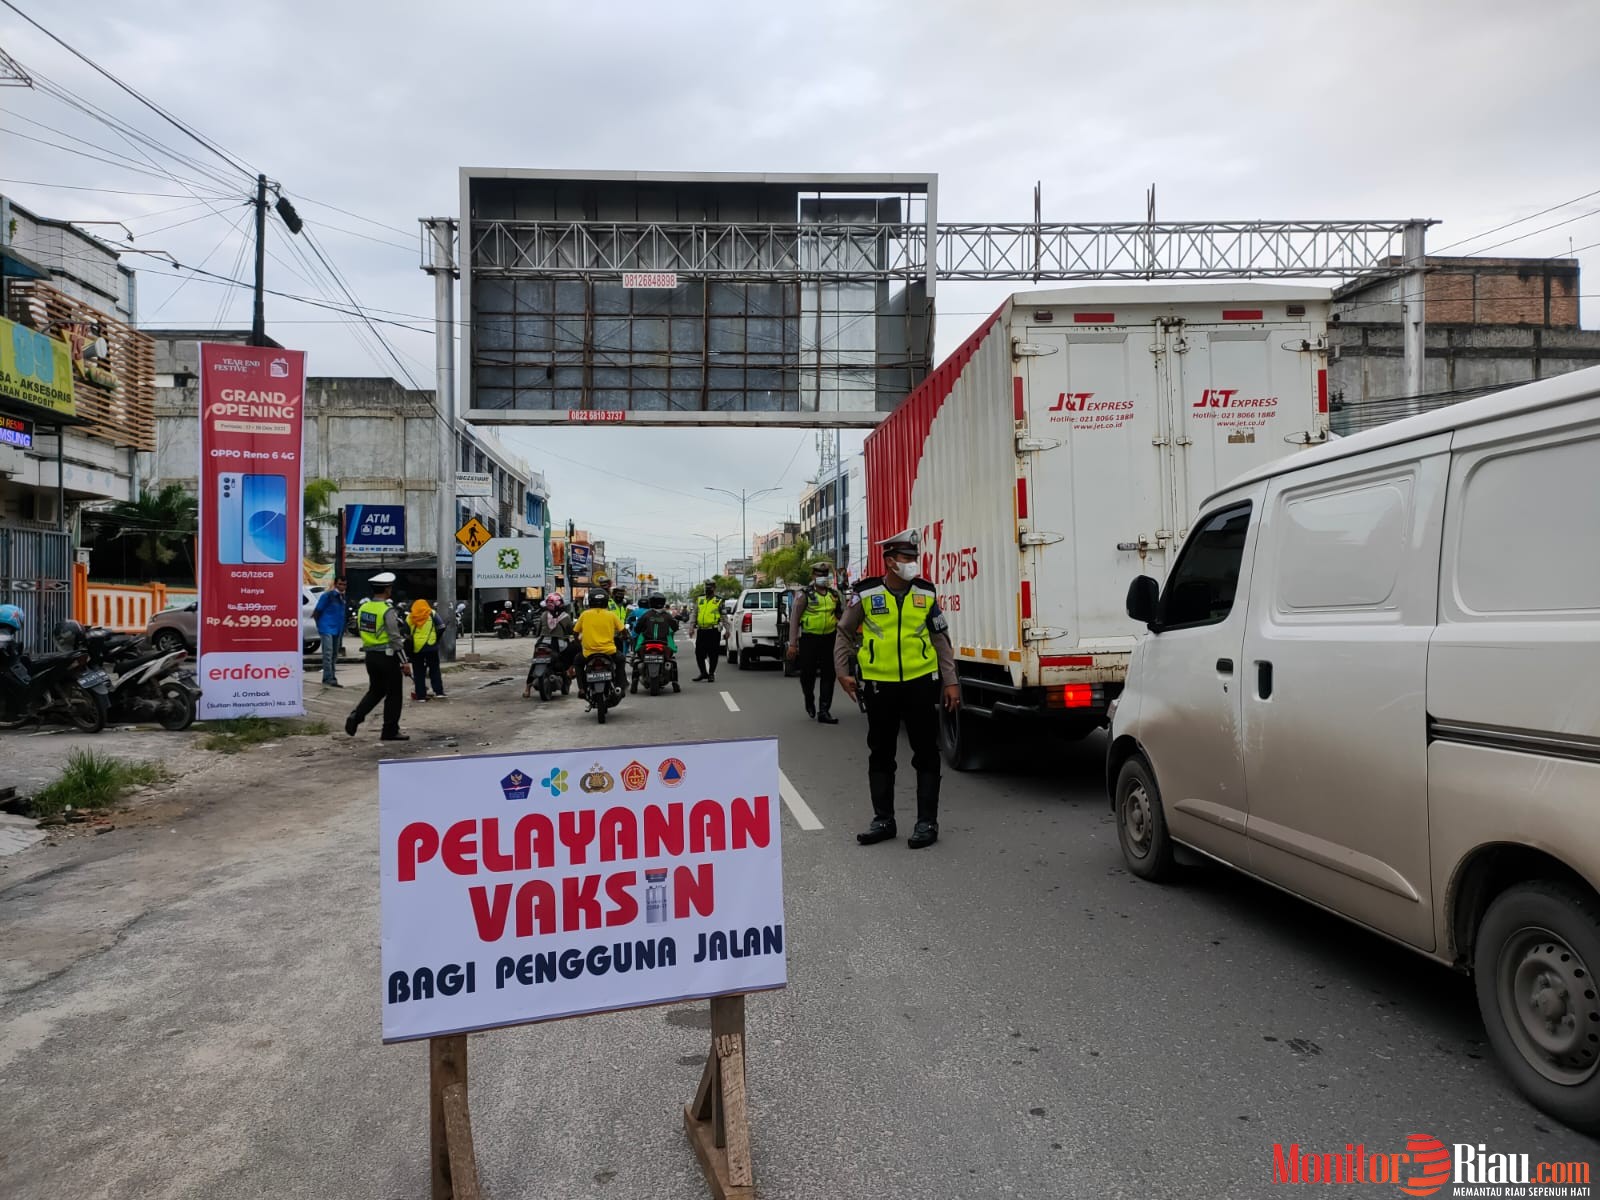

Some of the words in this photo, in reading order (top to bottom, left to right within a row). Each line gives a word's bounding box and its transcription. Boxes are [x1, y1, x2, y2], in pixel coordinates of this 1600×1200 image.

[214, 364, 247, 373] FESTIVE
[20, 378, 72, 403] AKSESORIS
[221, 388, 286, 405] GRAND
[23, 391, 54, 408] DEPOSIT
[1049, 392, 1095, 412] J&T
[1087, 400, 1134, 411] EXPRESS
[1193, 389, 1239, 408] J&T
[1231, 397, 1278, 408] EXPRESS
[211, 402, 295, 419] OPENING
[606, 411, 623, 420] 3737
[1237, 411, 1255, 419] 8066
[1079, 415, 1093, 423] 021
[1073, 422, 1123, 430] www.jet.co.id
[210, 449, 241, 458] OPPO
[243, 450, 270, 459] Reno
[272, 451, 279, 460] 6
[281, 452, 295, 460] 4G
[365, 513, 391, 523] ATM
[373, 525, 396, 535] BCA
[240, 587, 265, 595] Hanya
[206, 616, 220, 627] Rp
[222, 615, 298, 628] 4.999.000
[209, 664, 290, 681] erafone
[397, 795, 770, 882] PELAYANAN
[388, 961, 476, 1004] BAGI
[495, 936, 677, 990] PENGGUNA
[693, 924, 783, 963] JALAN
